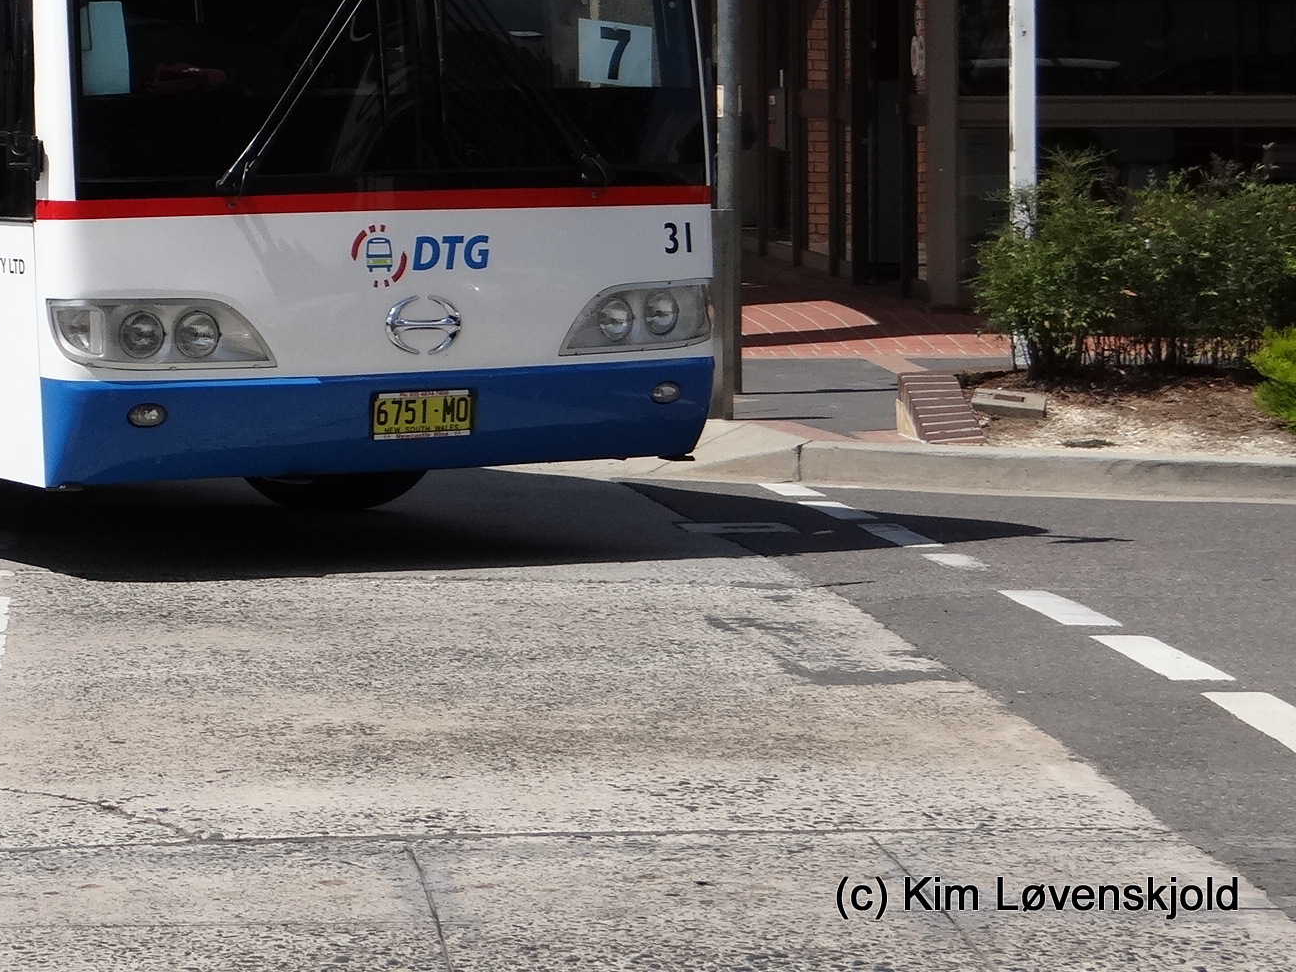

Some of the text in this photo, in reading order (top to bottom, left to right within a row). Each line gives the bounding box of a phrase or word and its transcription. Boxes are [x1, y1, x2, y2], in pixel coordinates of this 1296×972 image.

[600, 26, 631, 80] 7
[412, 234, 490, 271] DTG
[663, 222, 693, 255] 31
[8, 258, 26, 275] LTD
